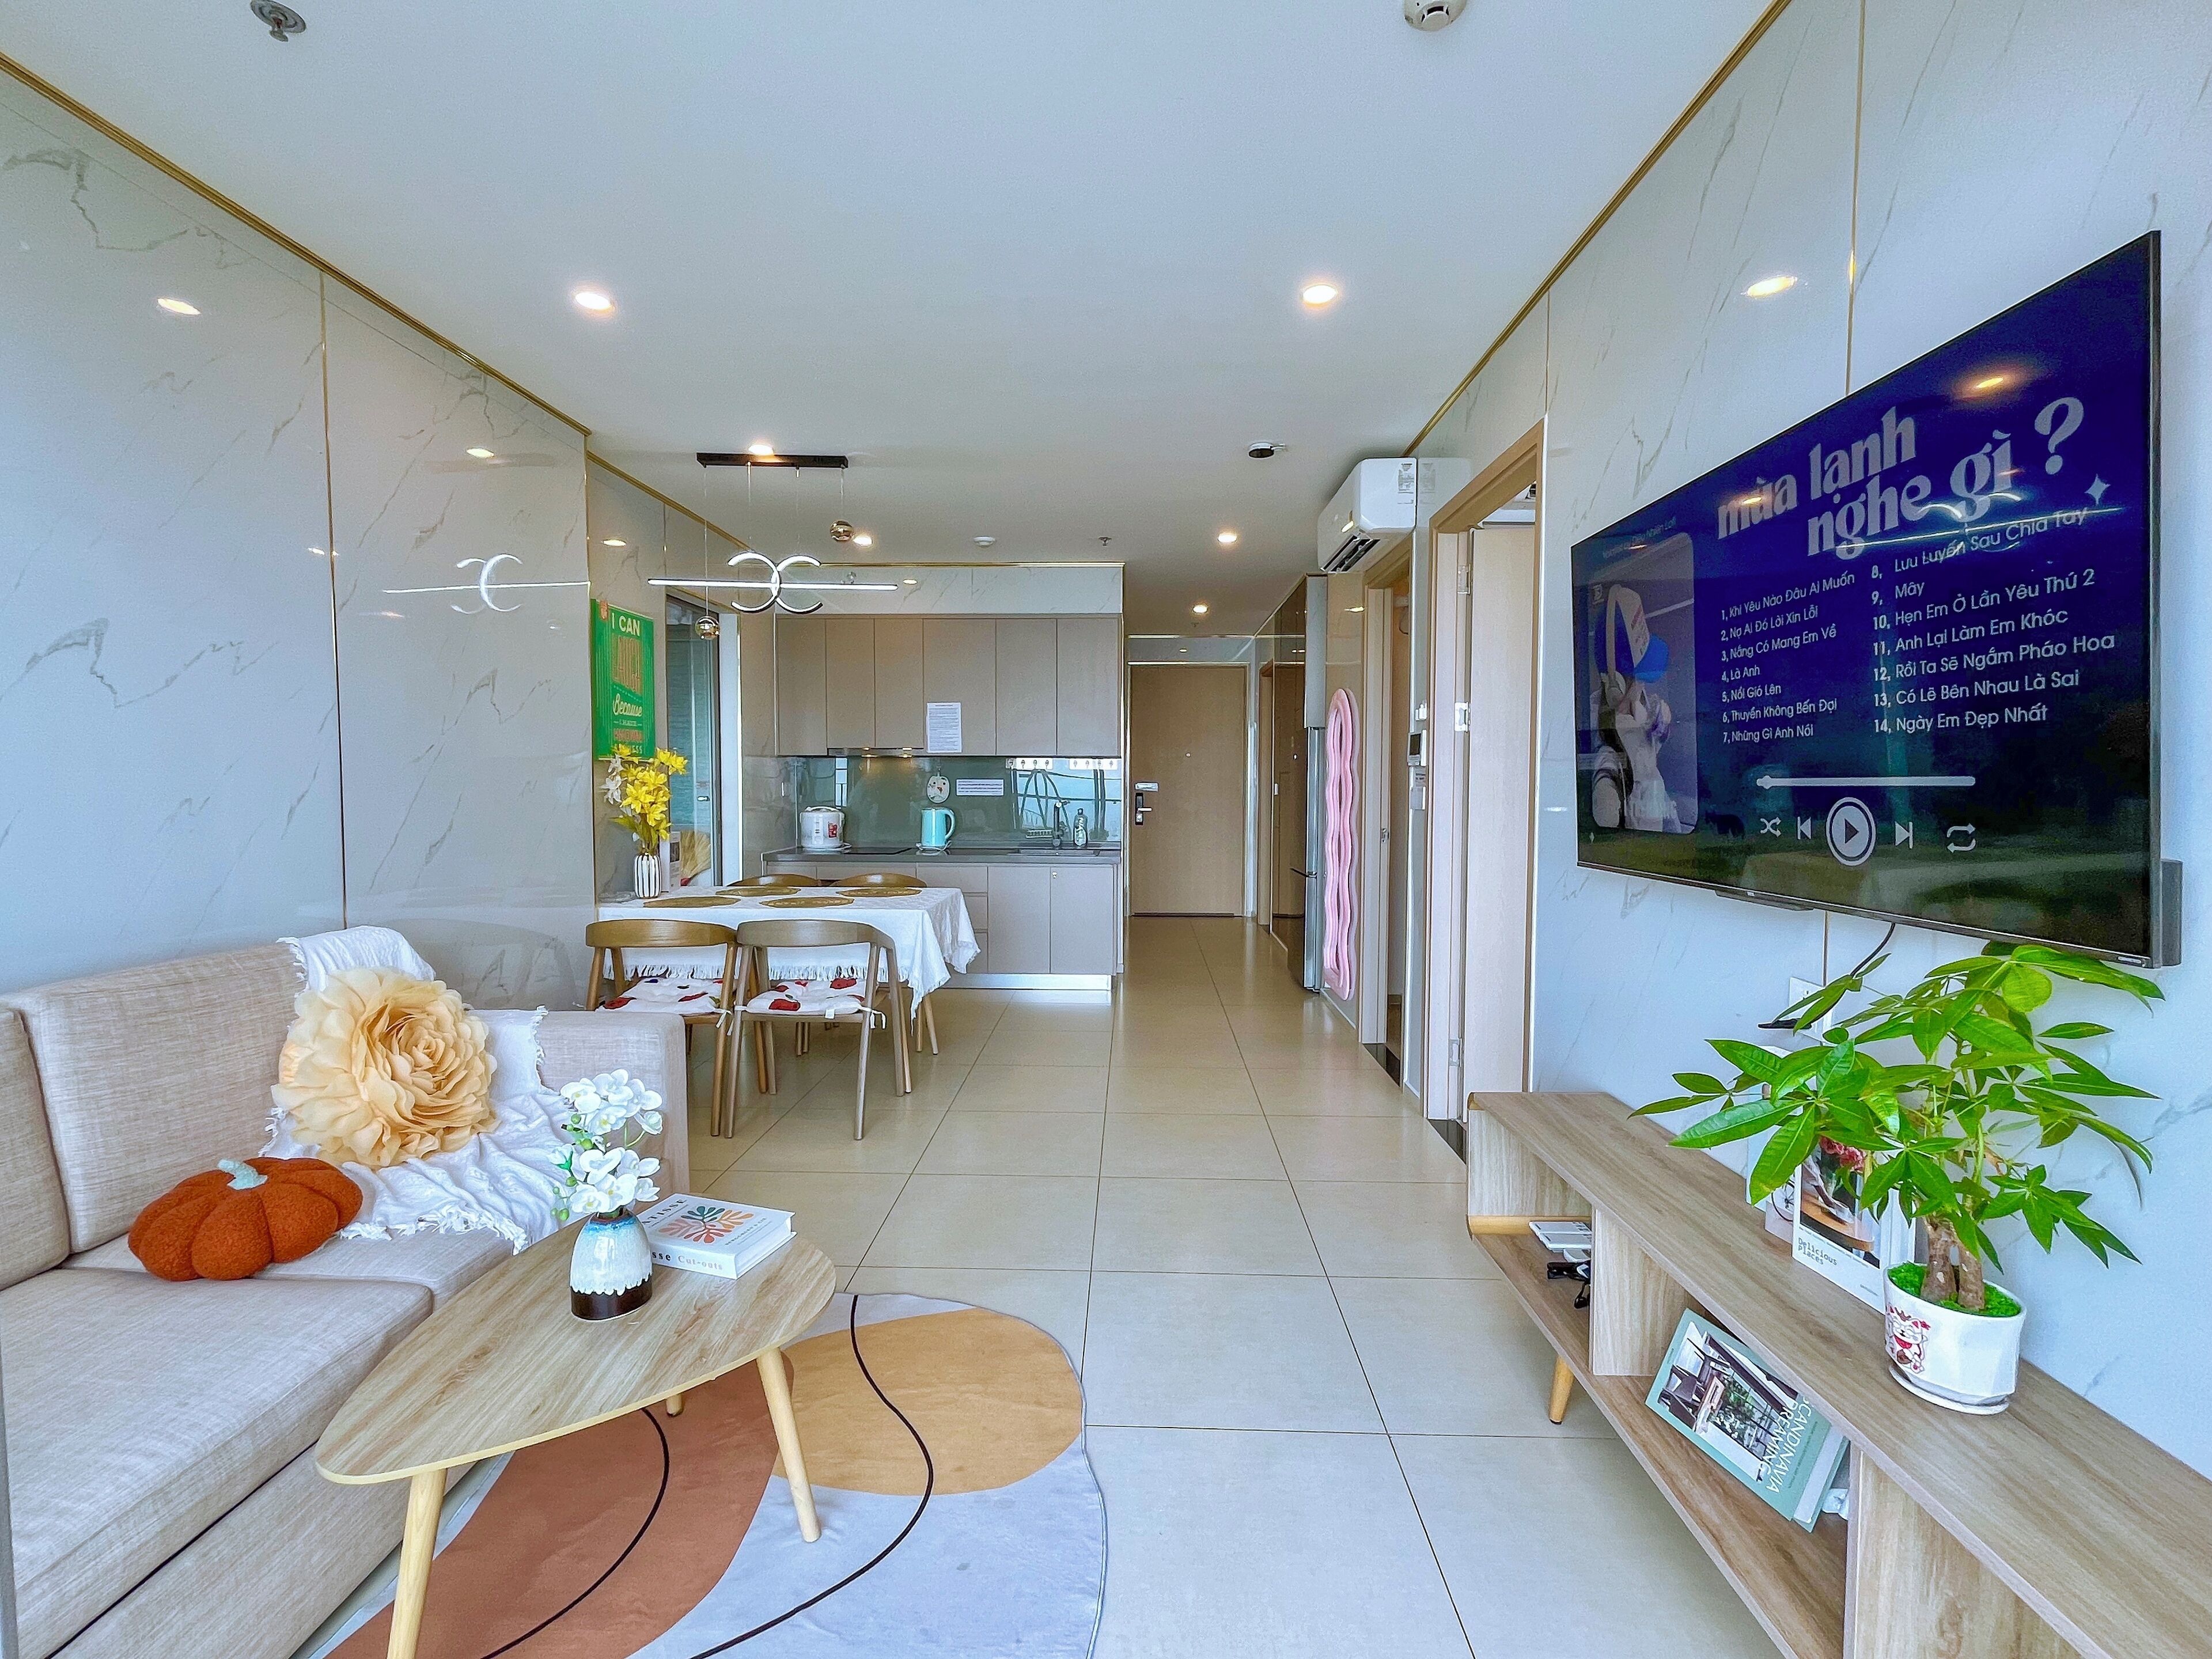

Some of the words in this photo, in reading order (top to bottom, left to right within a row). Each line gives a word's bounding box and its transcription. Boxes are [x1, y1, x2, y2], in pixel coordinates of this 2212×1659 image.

[1718, 474, 1798, 540] mùa
[1809, 406, 1916, 503] lạnh
[1808, 475, 1932, 560] nghe
[1949, 430, 2012, 521] gì
[2034, 397, 2084, 475] ?
[1971, 532, 2001, 551] Sau
[2006, 517, 2048, 541] Chia
[2054, 507, 2088, 528] Tay
[1744, 600, 1760, 614] Yêu
[1763, 594, 1783, 608] Nào
[1785, 587, 1806, 602] Đâu
[1809, 581, 1820, 596] Ai
[1823, 570, 1855, 592] Muốn
[1871, 590, 1883, 605] 9,
[1895, 582, 1925, 599] Mây
[1873, 614, 1891, 630] 10,
[1895, 610, 1922, 627] Hẹn
[1926, 604, 1948, 619] Em
[1971, 589, 2001, 609] Lần
[2005, 584, 2039, 602] Yêu
[2082, 569, 2095, 586] 2
[611, 612, 615, 630] I
[619, 615, 641, 637] CAN
[1721, 630, 1729, 642] 2,
[1755, 617, 1768, 632] Đó
[1786, 611, 1801, 626] Xin
[1873, 641, 1891, 656] 11,
[1895, 635, 1923, 652] Anh
[1927, 628, 1948, 648] Lại
[1952, 625, 1985, 642] Làm
[1990, 619, 2015, 635] Em
[2021, 608, 2069, 630] Khóc
[1721, 650, 1729, 662] 3,
[1756, 640, 1769, 654] Có
[1771, 635, 1800, 651] Mang
[1802, 631, 1818, 645] Em
[1873, 666, 1892, 681] 12,
[1896, 660, 1916, 679] Rồi
[1919, 660, 1937, 675] Ta
[1940, 656, 1959, 672] Sẽ
[1963, 647, 2014, 671] Ngắm
[2019, 640, 2067, 661] Pháo
[2073, 635, 2115, 653] Hoa
[1721, 671, 1729, 683] 4,
[1730, 668, 1741, 680] Là
[1743, 664, 1760, 678] Anh
[1874, 692, 1892, 708] 13,
[1896, 688, 1916, 704] Có
[1920, 687, 1937, 702] Lẽ
[1941, 684, 1969, 700] Bên
[1974, 680, 2019, 696] Nhau
[2024, 673, 2046, 691] Là
[2051, 669, 2080, 688] Sai
[612, 693, 643, 717] Because
[1747, 684, 1763, 699] Gió
[1764, 683, 1782, 696] Lên
[1763, 704, 1794, 718] Không
[1796, 699, 1816, 714] Bến
[1874, 718, 1892, 734] 14,
[1896, 714, 1933, 734] Ngày
[1937, 713, 1960, 728] Em
[1964, 711, 1999, 729] Đẹp
[2004, 702, 2049, 724] Nhất
[1723, 732, 1730, 744] 7,
[1762, 728, 1773, 740] Gì
[1774, 725, 1794, 739] Anh
[1796, 723, 1813, 737] Nói
[677, 1255, 723, 1270] Cut-outs
[1798, 1237, 1838, 1266] Delicious
[1798, 1245, 1824, 1266] Places
